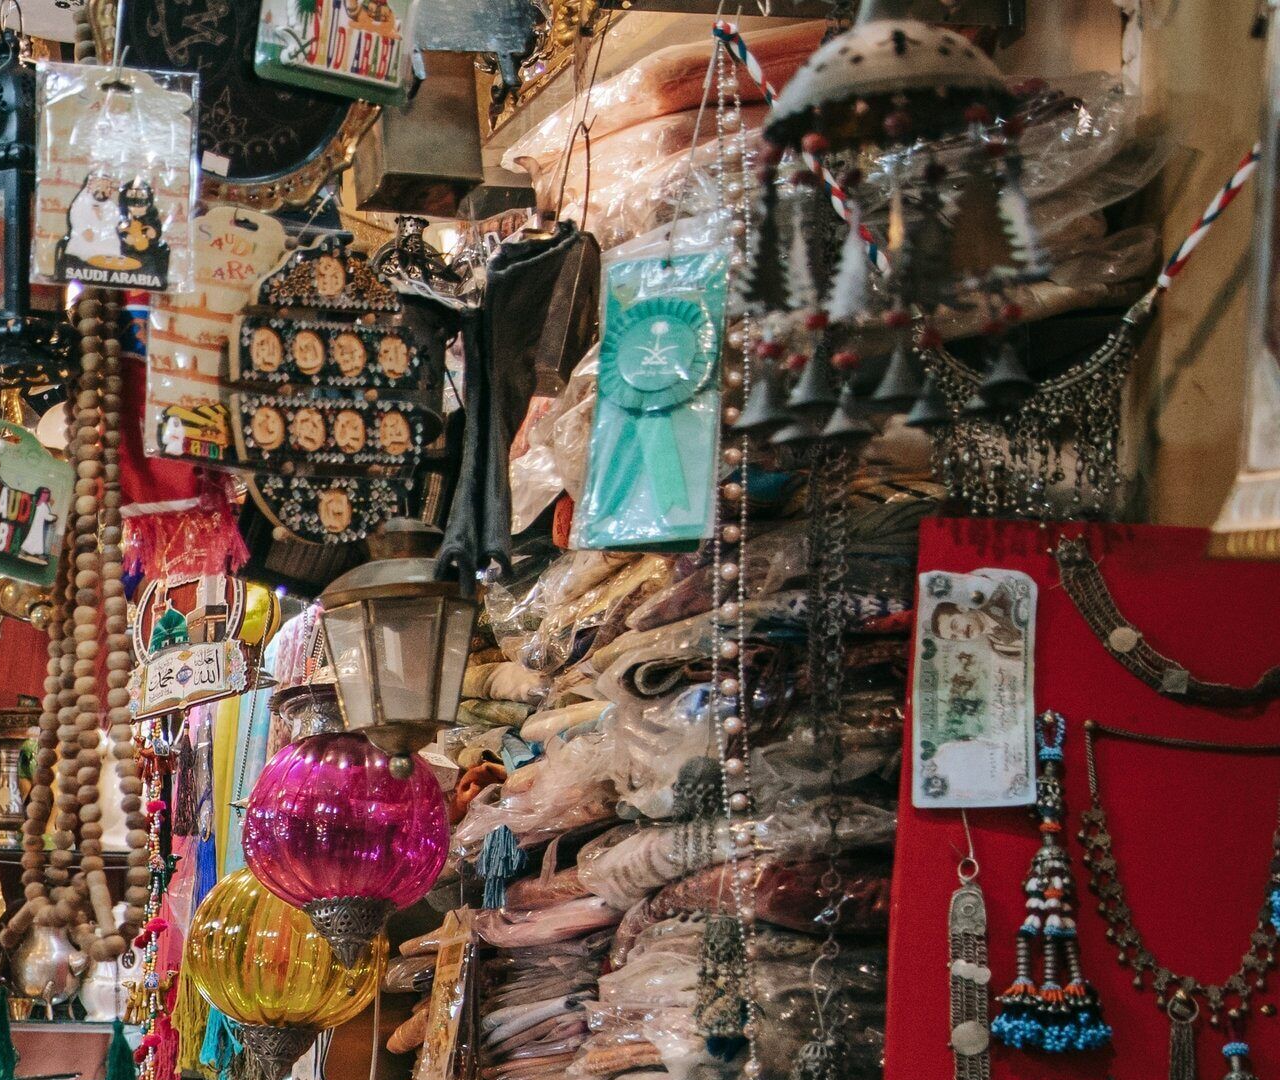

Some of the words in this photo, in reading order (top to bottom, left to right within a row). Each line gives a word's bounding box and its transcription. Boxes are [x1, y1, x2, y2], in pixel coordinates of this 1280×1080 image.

[198, 223, 258, 257] SAUDI
[65, 266, 109, 282] SAUDI
[110, 271, 162, 287] ARABIA
